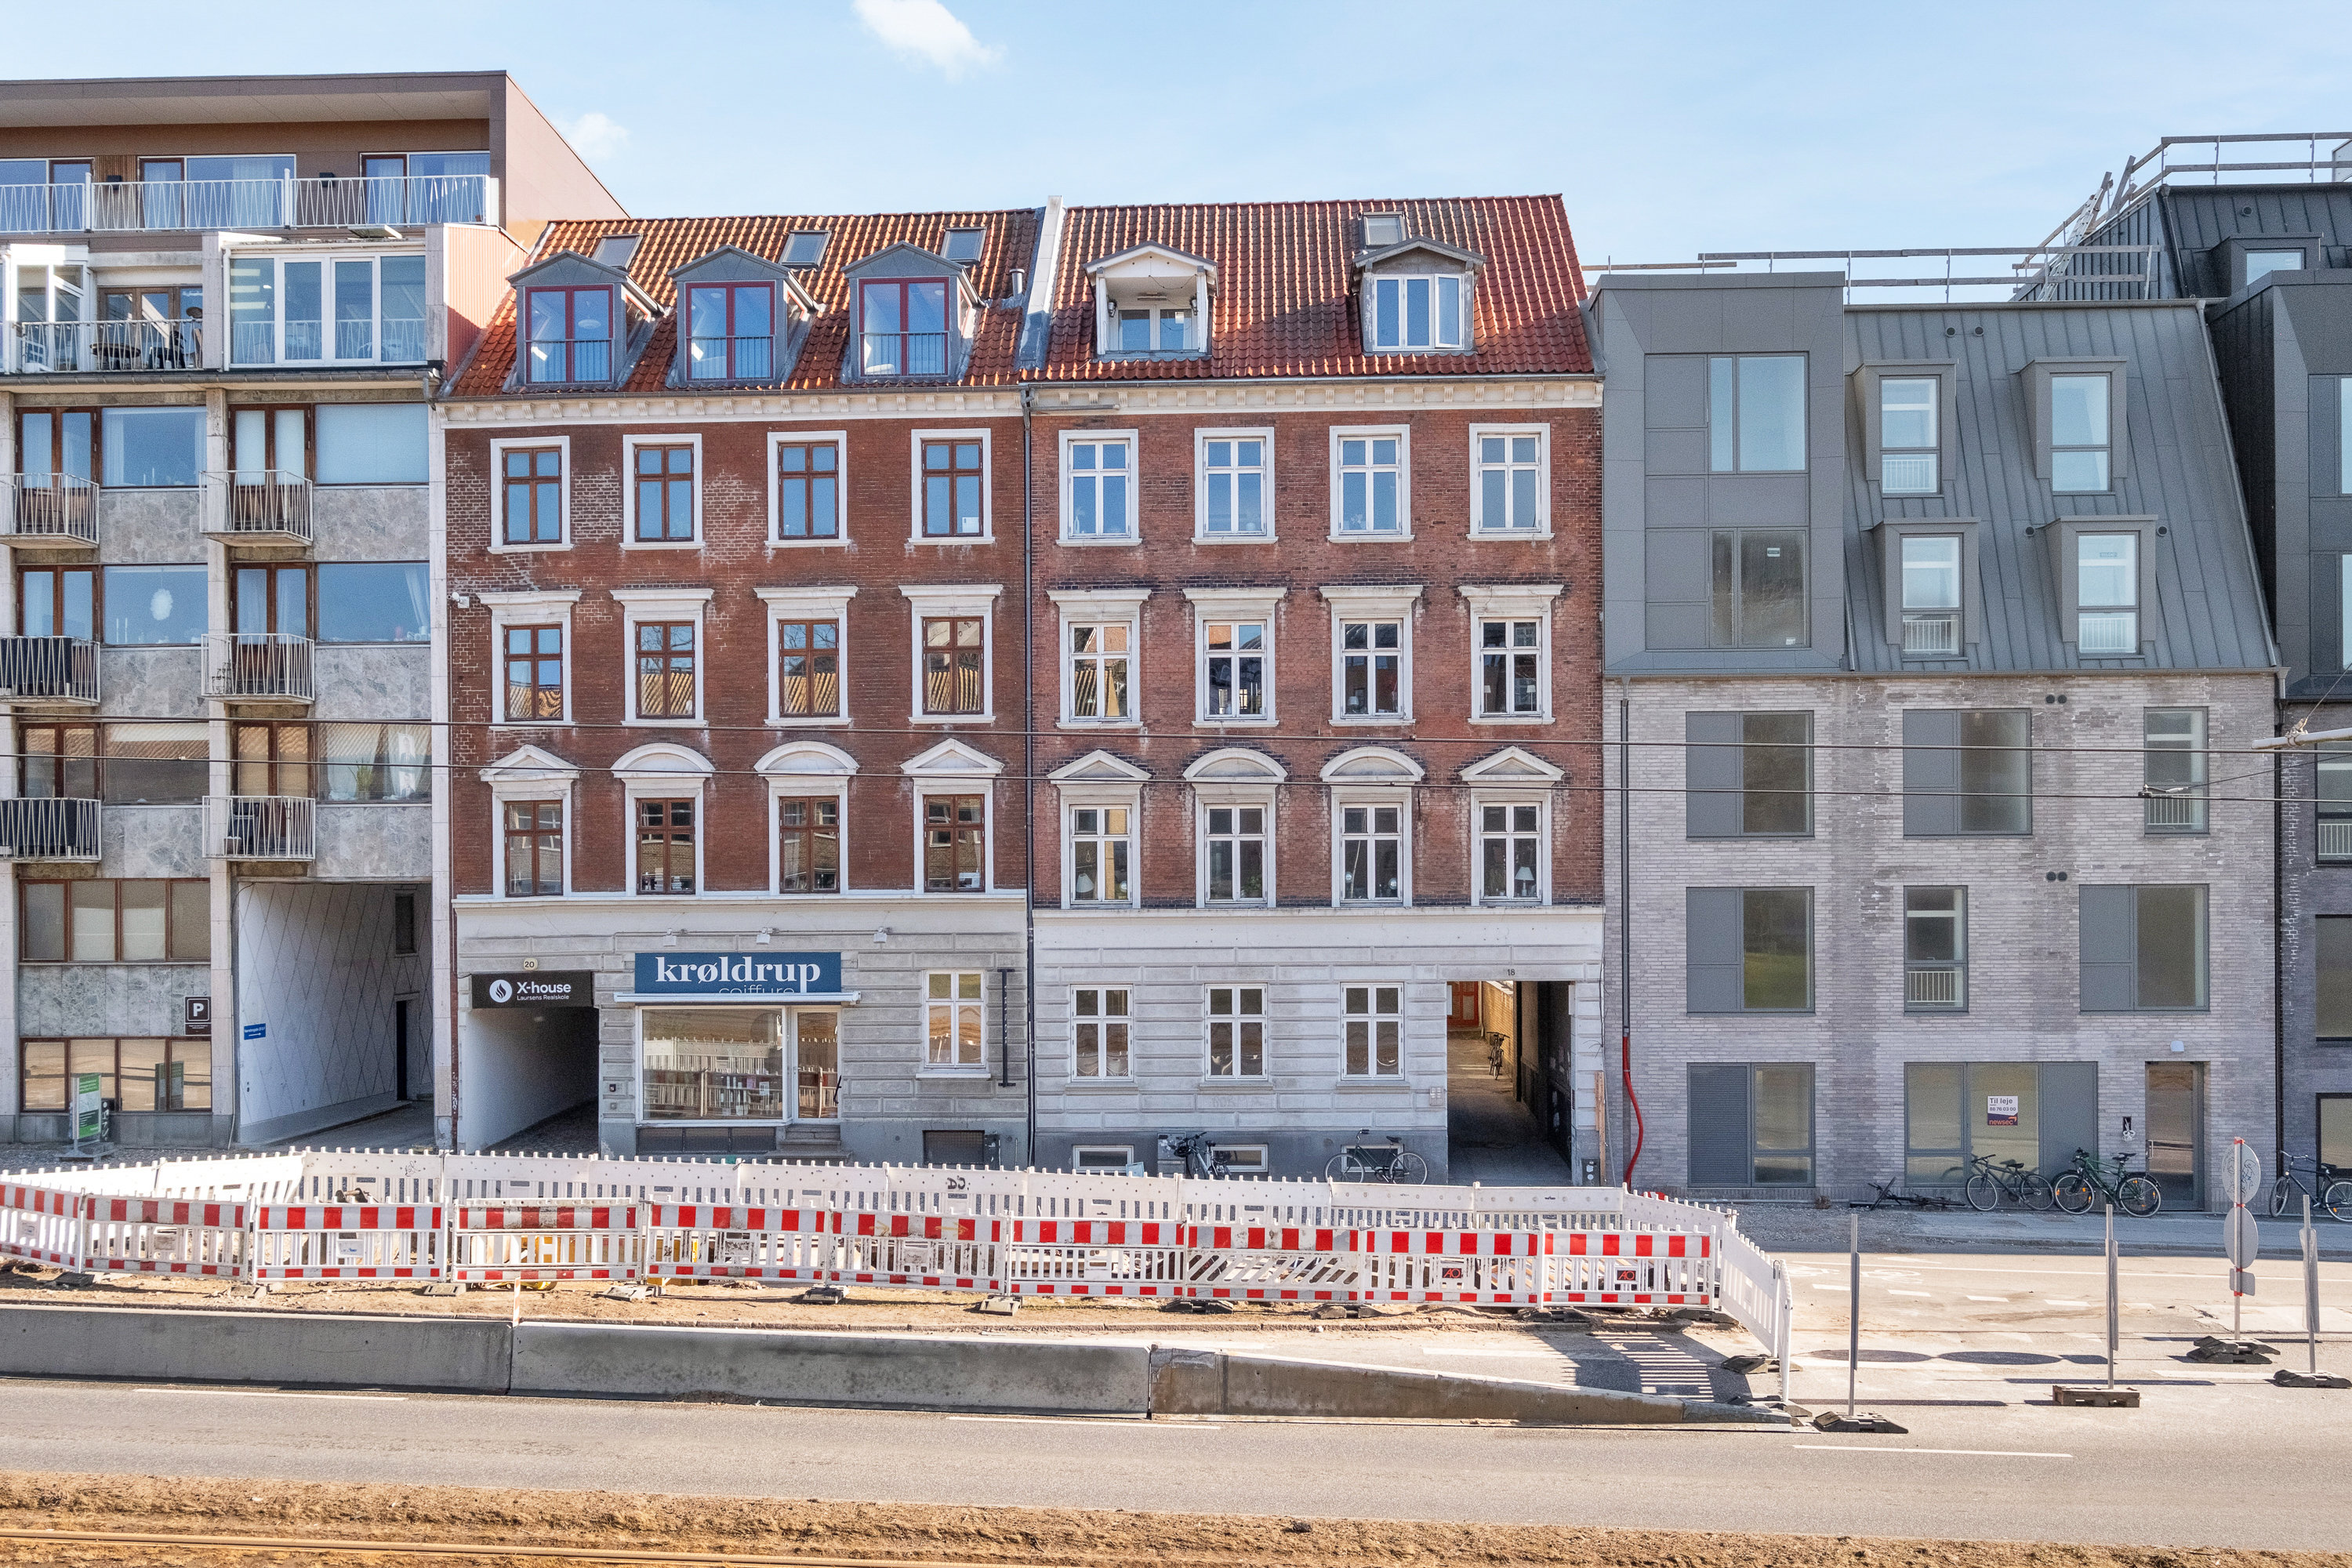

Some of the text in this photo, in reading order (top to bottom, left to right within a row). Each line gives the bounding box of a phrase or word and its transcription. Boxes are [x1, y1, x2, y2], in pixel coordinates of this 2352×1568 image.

[655, 956, 821, 993] krøldrup
[517, 981, 572, 994] X-house
[193, 1003, 205, 1017] P
[1443, 1268, 1461, 1279] AO
[1618, 1270, 1635, 1281] AO
